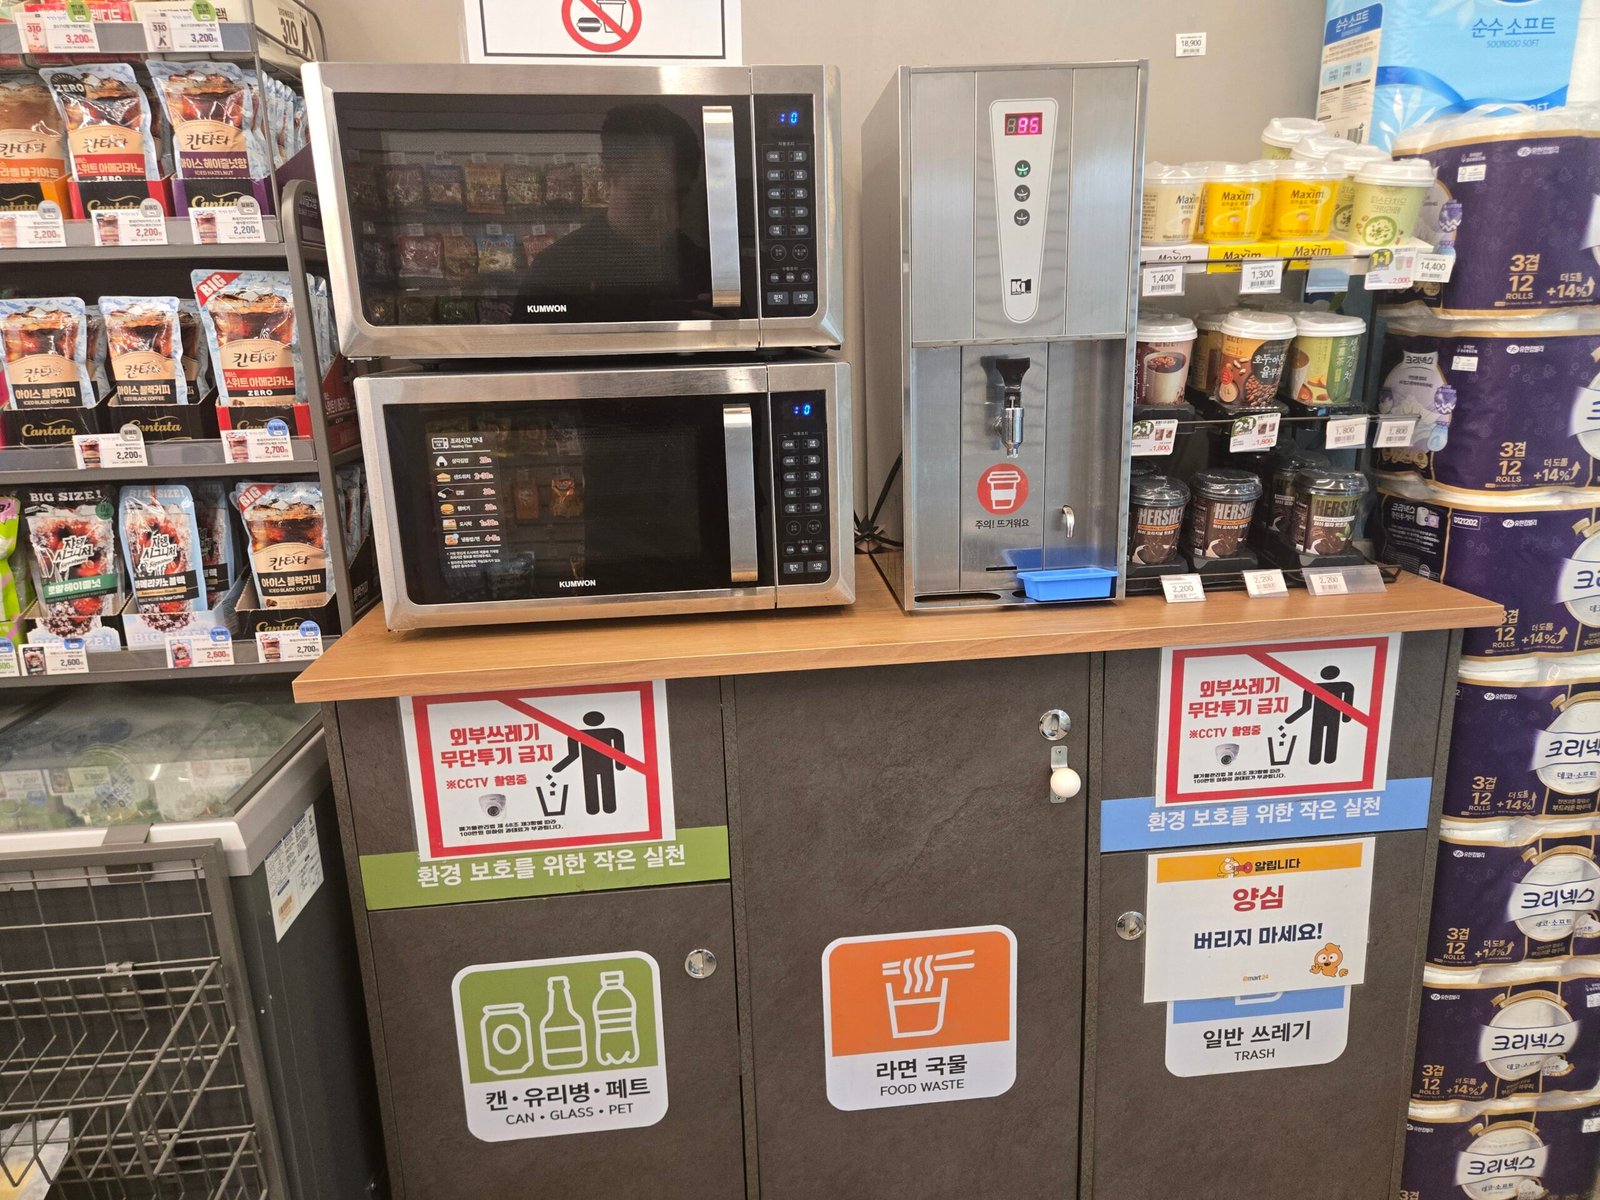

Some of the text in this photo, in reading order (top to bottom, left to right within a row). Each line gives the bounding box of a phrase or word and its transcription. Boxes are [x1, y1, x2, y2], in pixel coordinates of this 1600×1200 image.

[1472, 17, 1556, 38] 순수 소프트
[1181, 39, 1202, 48] 18,900
[1486, 39, 1540, 48] SOONSOO SOFT
[54, 84, 84, 93] ZERO
[185, 134, 230, 150] 칸타타
[99, 162, 145, 174] 아메리카노
[204, 158, 247, 169] 헤이즐넛향
[1221, 191, 1254, 201] Maxim
[1290, 189, 1324, 199] Maxim
[1223, 251, 1262, 260] Maxim
[1293, 246, 1332, 256] Maxim
[1372, 251, 1391, 267] 1+1
[1509, 253, 1540, 272] 3겹
[1420, 262, 1447, 271] 14,400
[1152, 273, 1174, 284] 1,400
[1251, 269, 1274, 280] 1,300
[199, 274, 227, 298] BIG
[1508, 275, 1534, 292] 12
[1505, 292, 1533, 300] ROLLS
[1546, 284, 1587, 298] +14%
[527, 304, 567, 313] KUMWON
[233, 352, 278, 367] 칸타타
[227, 376, 294, 388] 스위트 아메리카노
[15, 387, 76, 399] 아이스 블랙커피
[22, 424, 77, 437] Cantata
[1133, 422, 1152, 435] 2+1
[1235, 417, 1254, 431] 2+1
[1499, 441, 1526, 458] 3겹
[1498, 460, 1521, 475] 12
[1495, 475, 1522, 483] ROLLS
[1533, 469, 1570, 482] +14%
[29, 493, 54, 502] BIG
[129, 489, 152, 498] BIG
[239, 486, 262, 507] BIG
[975, 518, 1030, 529] 주의! 뜨거워요
[64, 537, 86, 550] 자뎅
[152, 535, 170, 548] 자뎅
[54, 546, 94, 562] 시그니처
[142, 544, 177, 561] 시그니처
[269, 556, 311, 571] 칸타타
[169, 576, 186, 586] 블랙
[261, 574, 321, 588] 아이스 블랙커피
[559, 579, 596, 588] KUMWON
[1172, 585, 1194, 593] 2,200
[1495, 626, 1515, 641] 12
[1521, 632, 1556, 644] +14%
[1492, 640, 1515, 649] ROLLS
[1199, 677, 1281, 698] 외부쓰레기
[1187, 696, 1289, 719] 무단투기 금지
[449, 723, 540, 746] 외부쓰레기
[1232, 724, 1262, 738] 촬영중
[440, 744, 553, 769] 무단투기 금지
[494, 774, 527, 787] 촬영중
[1472, 776, 1497, 790] 3겹
[1471, 793, 1492, 805] 12
[1497, 800, 1531, 811] +14%
[1147, 796, 1382, 832] 환경 보호를 위한 작은 실천
[416, 844, 686, 887] 환경 보호를 위한 작은 실천
[1254, 858, 1301, 872] 알립니다
[1232, 885, 1285, 912] 양심
[1521, 888, 1595, 909] 크리넥스
[1194, 922, 1323, 950] 버리지 마세요!
[1446, 927, 1470, 941] 3겹
[1446, 943, 1466, 955] 12
[1475, 948, 1506, 958] +14%
[1203, 1020, 1312, 1049] 일반 쓰레기
[1491, 1032, 1565, 1052] 크리넥스
[1233, 1048, 1275, 1061] TRASH
[876, 1054, 968, 1080] 라면 국물
[1422, 1064, 1445, 1077] 3겹
[880, 1079, 965, 1096] FOOD WASTE
[1422, 1078, 1441, 1090] 12
[1447, 1085, 1479, 1096] +14%
[506, 1103, 634, 1125] CAN GLASS PET
[1467, 1155, 1536, 1175] 크리넥스
